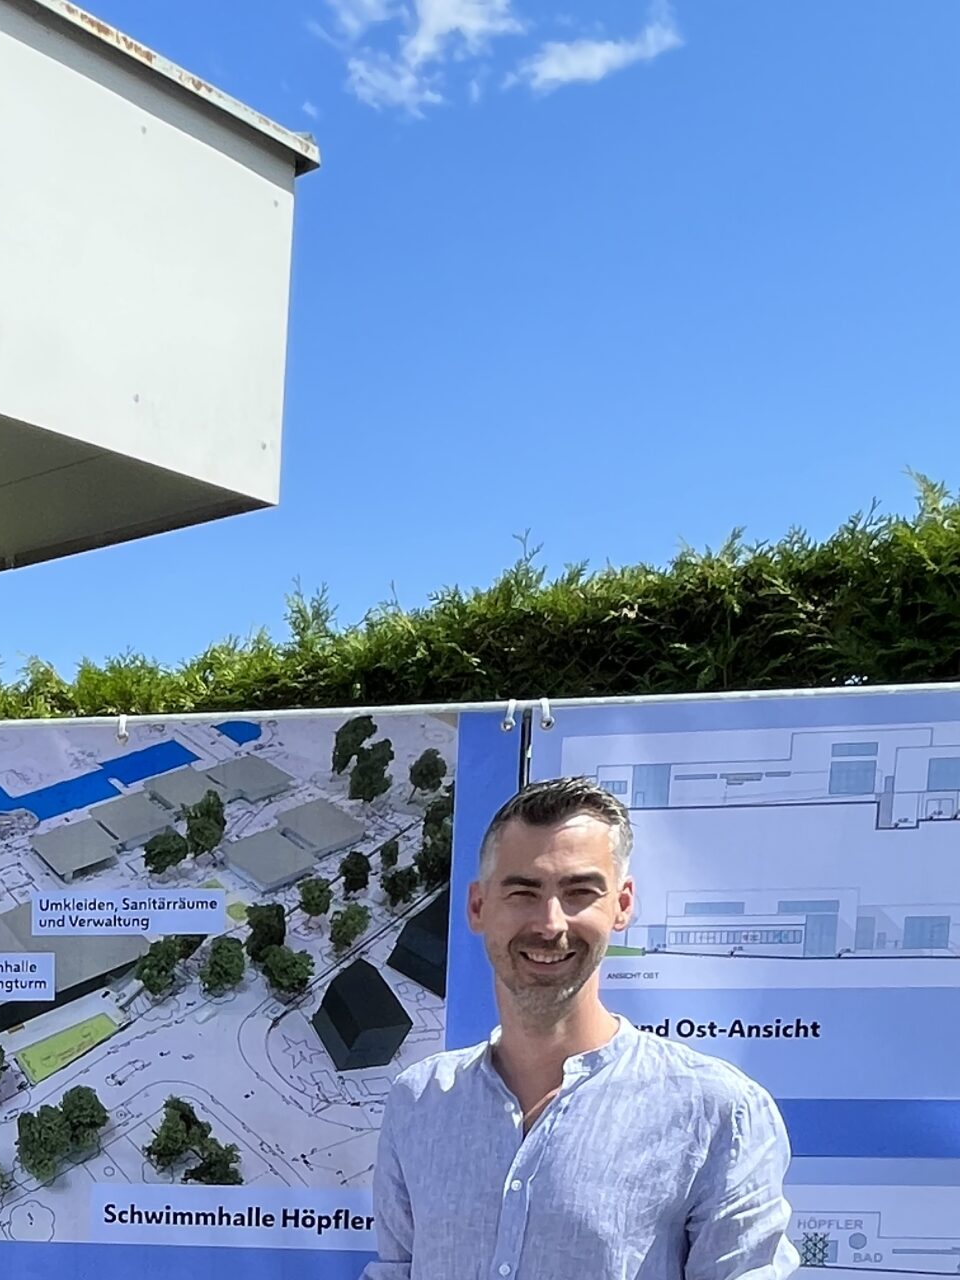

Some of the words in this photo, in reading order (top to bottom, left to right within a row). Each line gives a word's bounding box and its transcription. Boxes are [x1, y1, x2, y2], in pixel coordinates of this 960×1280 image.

[39, 897, 119, 913] Umkleiden,
[122, 897, 218, 911] Sanitärräume
[39, 915, 66, 928] und
[69, 915, 150, 931] Verwaltung
[676, 1018, 821, 1039] Ost-Ansicht
[103, 1204, 275, 1229] Schwimmhalle
[281, 1208, 375, 1235] Höpfler
[797, 1216, 864, 1230] HÖPFLER
[853, 1252, 883, 1263] BAD
